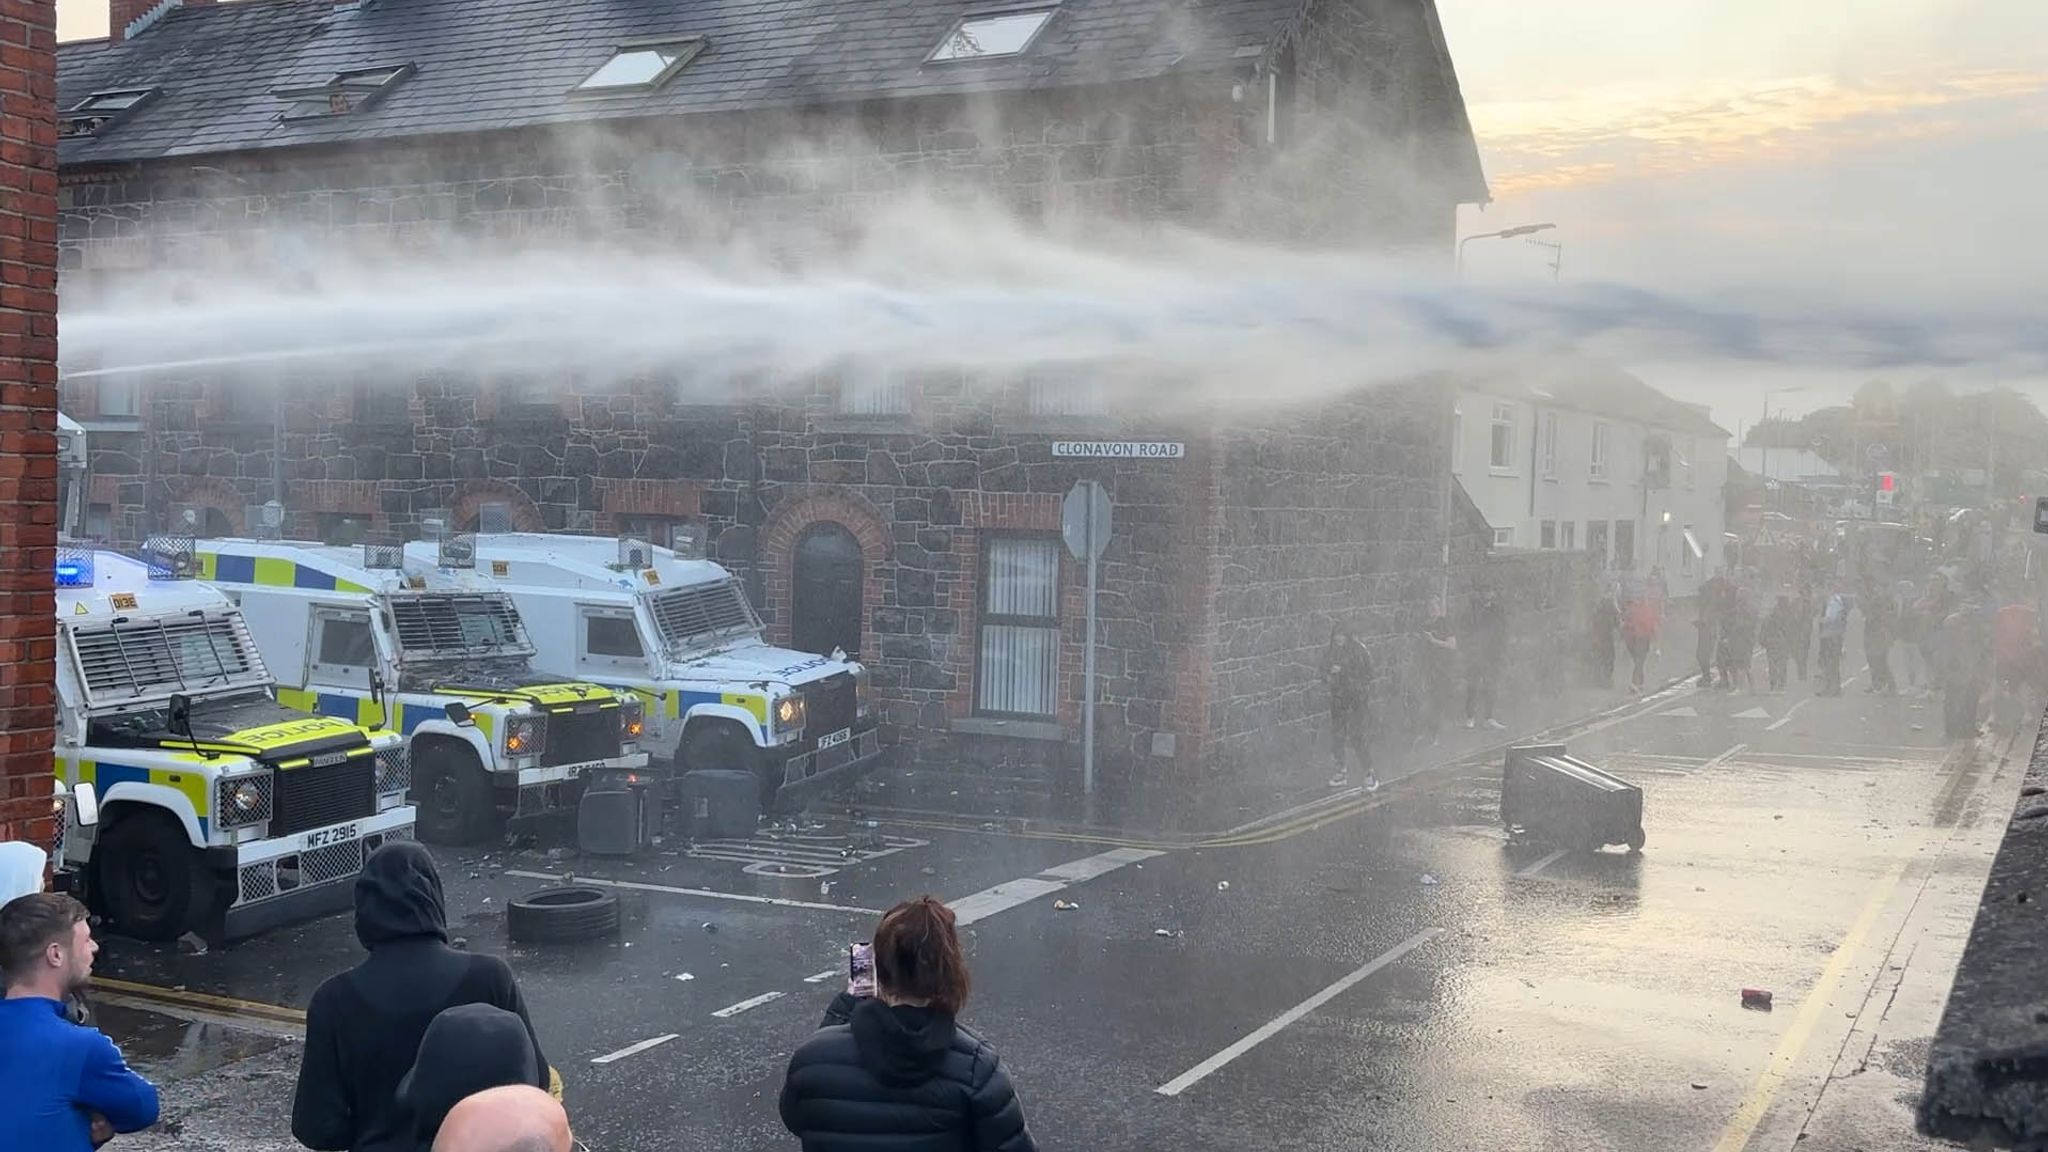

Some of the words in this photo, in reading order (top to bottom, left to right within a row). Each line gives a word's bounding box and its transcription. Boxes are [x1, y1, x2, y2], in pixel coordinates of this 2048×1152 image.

[1057, 442, 1133, 456] CLONAVON
[1139, 443, 1178, 456] ROAD
[241, 721, 343, 743] POLICE
[307, 830, 329, 848] MFZ
[332, 823, 356, 842] 2915
